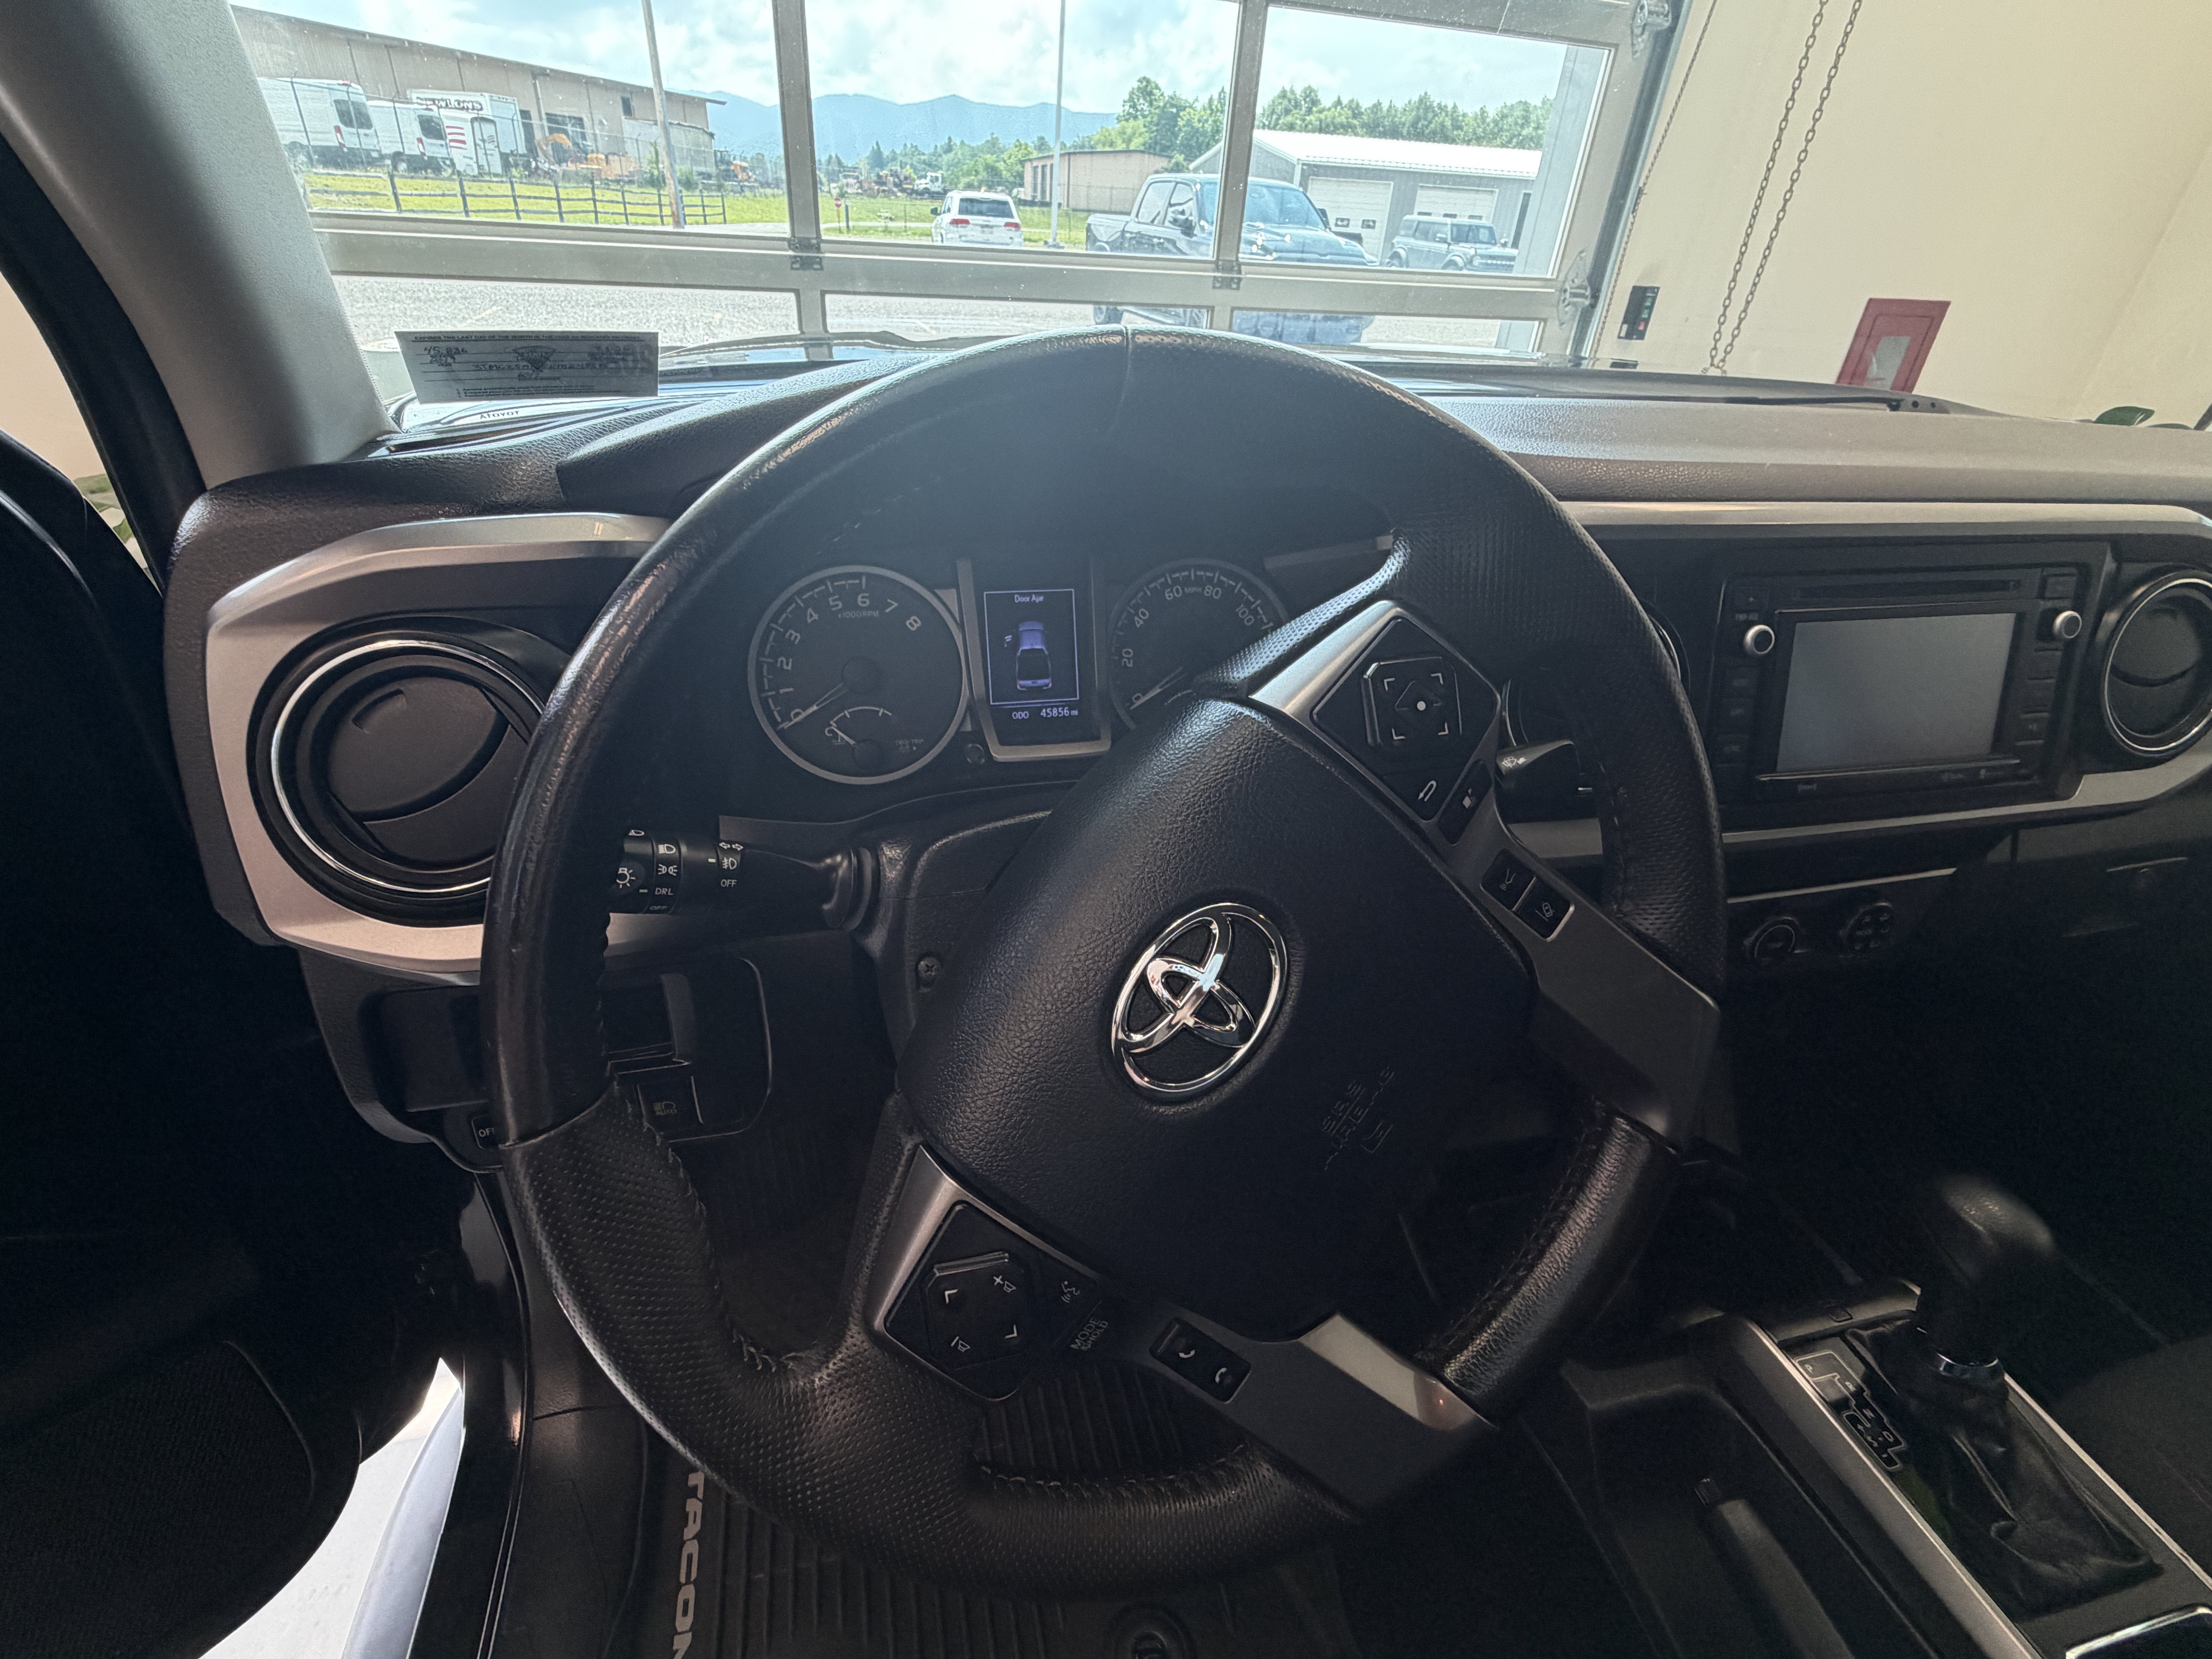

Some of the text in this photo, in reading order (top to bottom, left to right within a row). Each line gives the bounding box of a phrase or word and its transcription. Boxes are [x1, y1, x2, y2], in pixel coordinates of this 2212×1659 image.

[857, 593, 870, 607] 6
[1014, 594, 1044, 603] Door Ajar
[1165, 586, 1182, 600] 60
[1204, 586, 1222, 599] 80
[829, 595, 843, 611] 5
[885, 599, 899, 613] 7
[807, 608, 818, 623] 4
[1134, 608, 1149, 627] 40
[1235, 604, 1255, 626] 100
[905, 616, 922, 631] 8
[785, 629, 801, 644] 3
[778, 657, 792, 670] 2
[1122, 648, 1133, 668] 20
[1012, 711, 1029, 720] ODO
[1040, 707, 1070, 718] 45856
[721, 879, 737, 888] OFF
[655, 887, 674, 896] DRL
[1070, 1316, 1101, 1350] MODE
